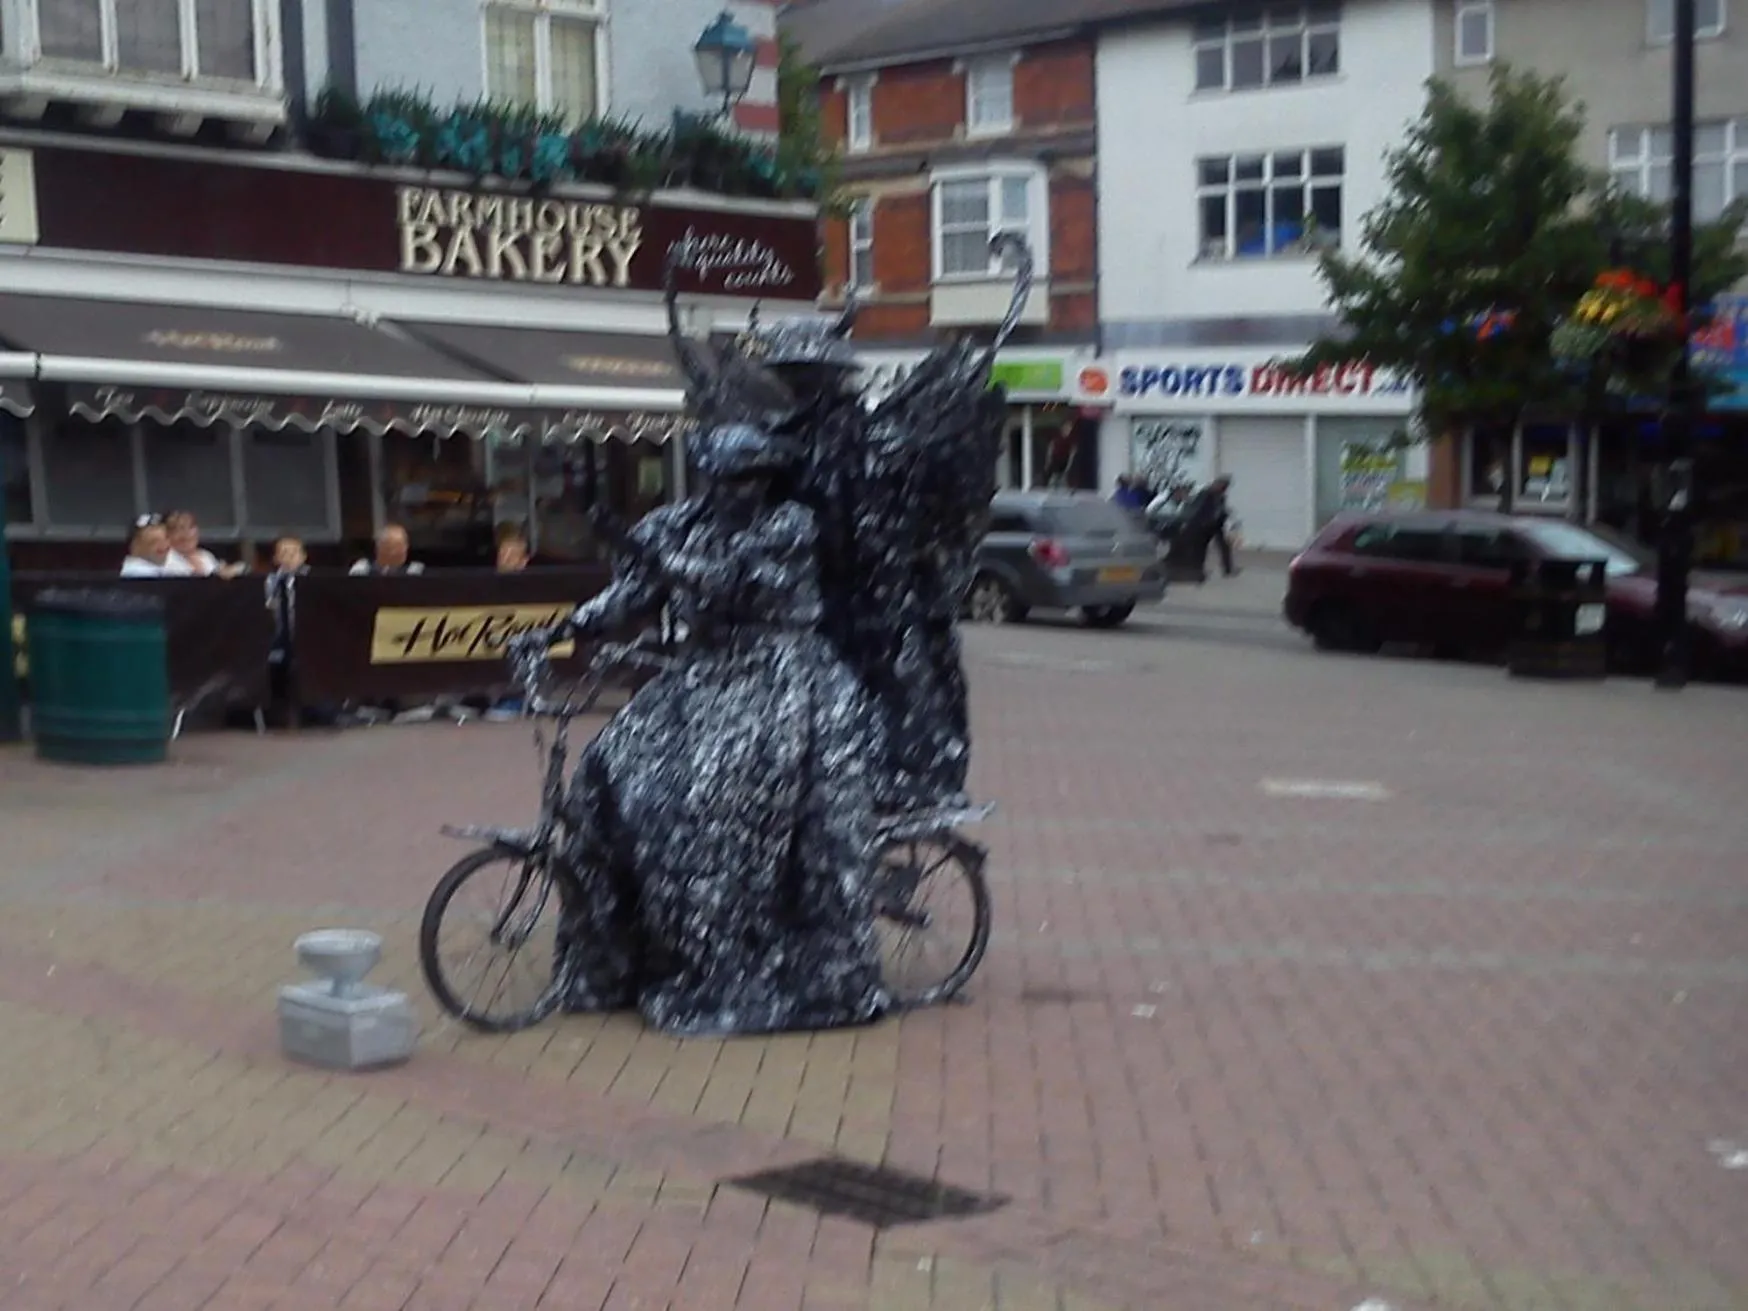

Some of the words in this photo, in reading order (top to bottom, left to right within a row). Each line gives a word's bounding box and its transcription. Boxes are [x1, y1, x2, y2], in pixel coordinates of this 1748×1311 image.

[398, 185, 643, 240] FARMHOUSE
[400, 221, 642, 287] BAKERY
[1119, 363, 1244, 396] SPORTS
[394, 614, 472, 656] Hot
